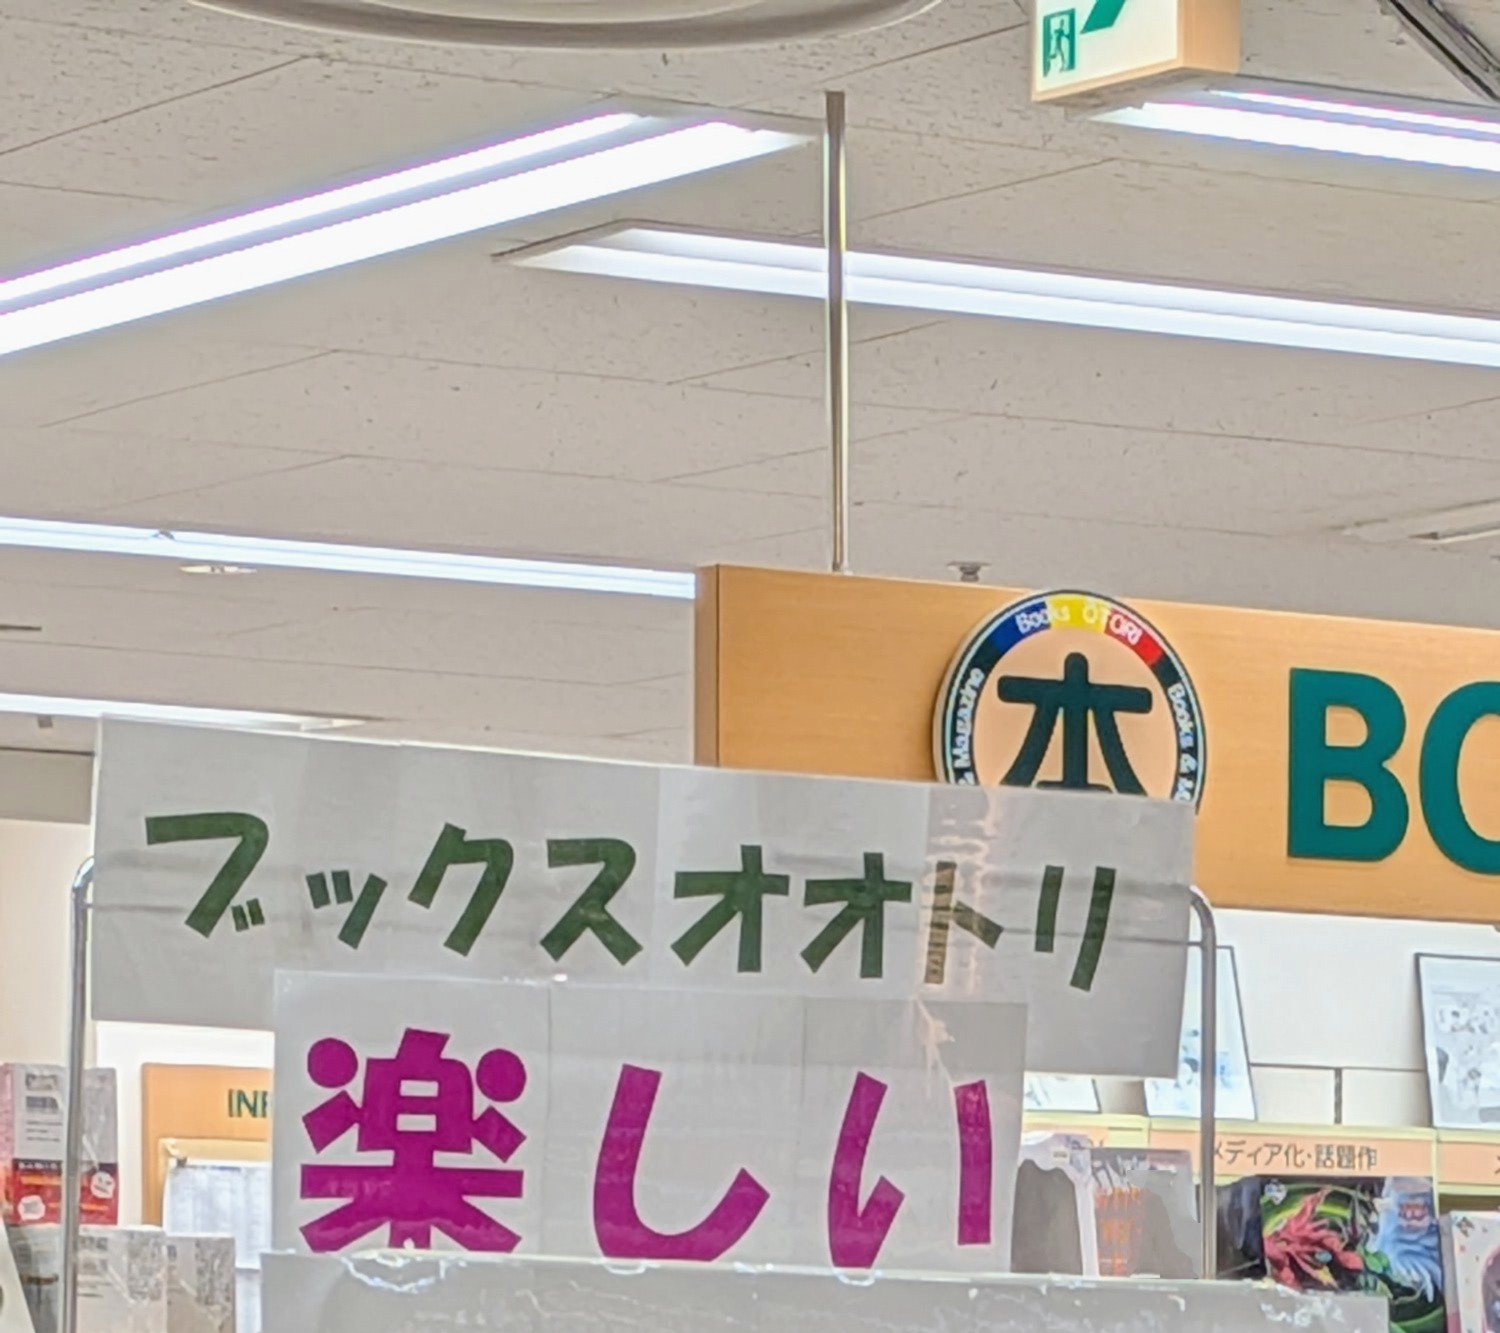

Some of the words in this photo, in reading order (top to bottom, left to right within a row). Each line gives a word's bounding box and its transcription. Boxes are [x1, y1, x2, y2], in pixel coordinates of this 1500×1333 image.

[1016, 604, 1071, 635] Books
[1167, 683, 1195, 750] Books
[146, 811, 1115, 991] ブックスオオトリ
[301, 1028, 992, 1267] 楽しい
